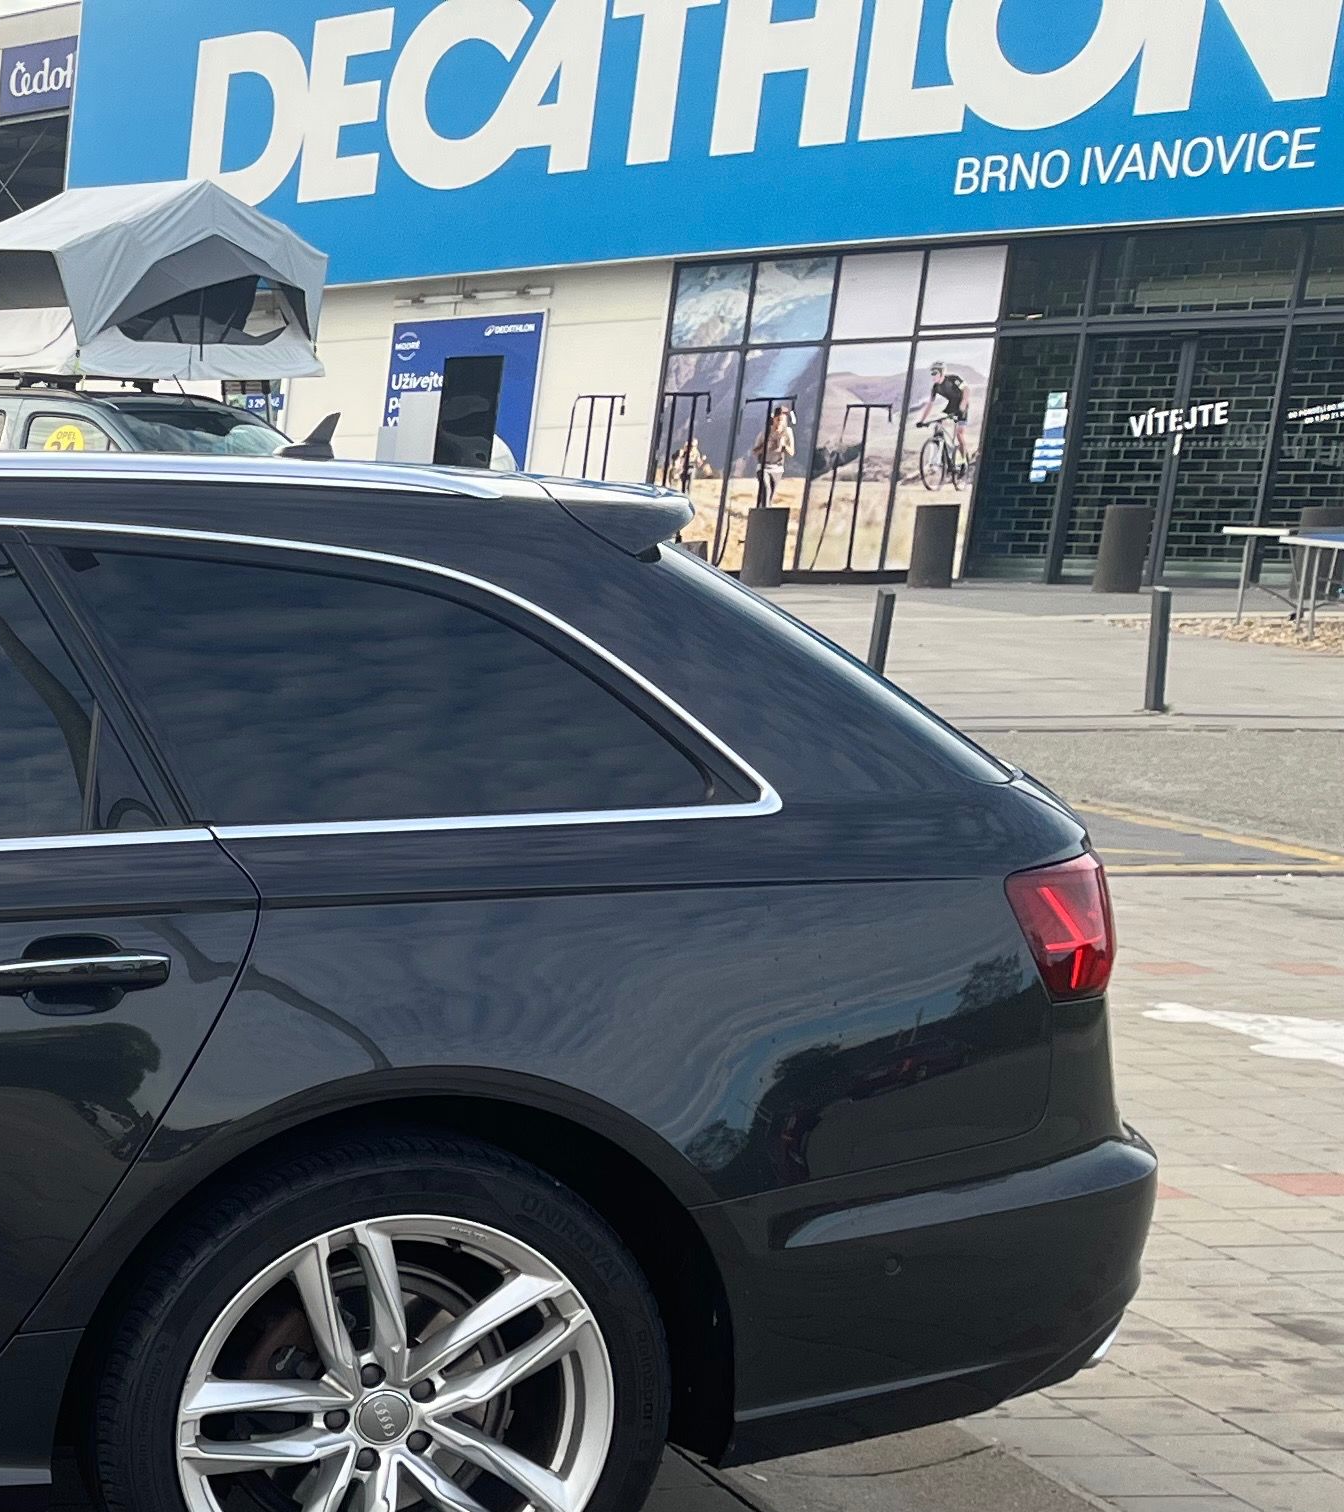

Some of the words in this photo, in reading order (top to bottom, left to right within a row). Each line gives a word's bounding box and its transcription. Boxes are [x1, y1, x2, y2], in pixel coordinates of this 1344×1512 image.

[187, 0, 1343, 207] DECATHLON
[953, 149, 1071, 195] BRNO
[1080, 126, 1322, 186] IVANOVICE
[56, 430, 77, 441] OPEL
[1130, 401, 1229, 438] VÍTEJTE
